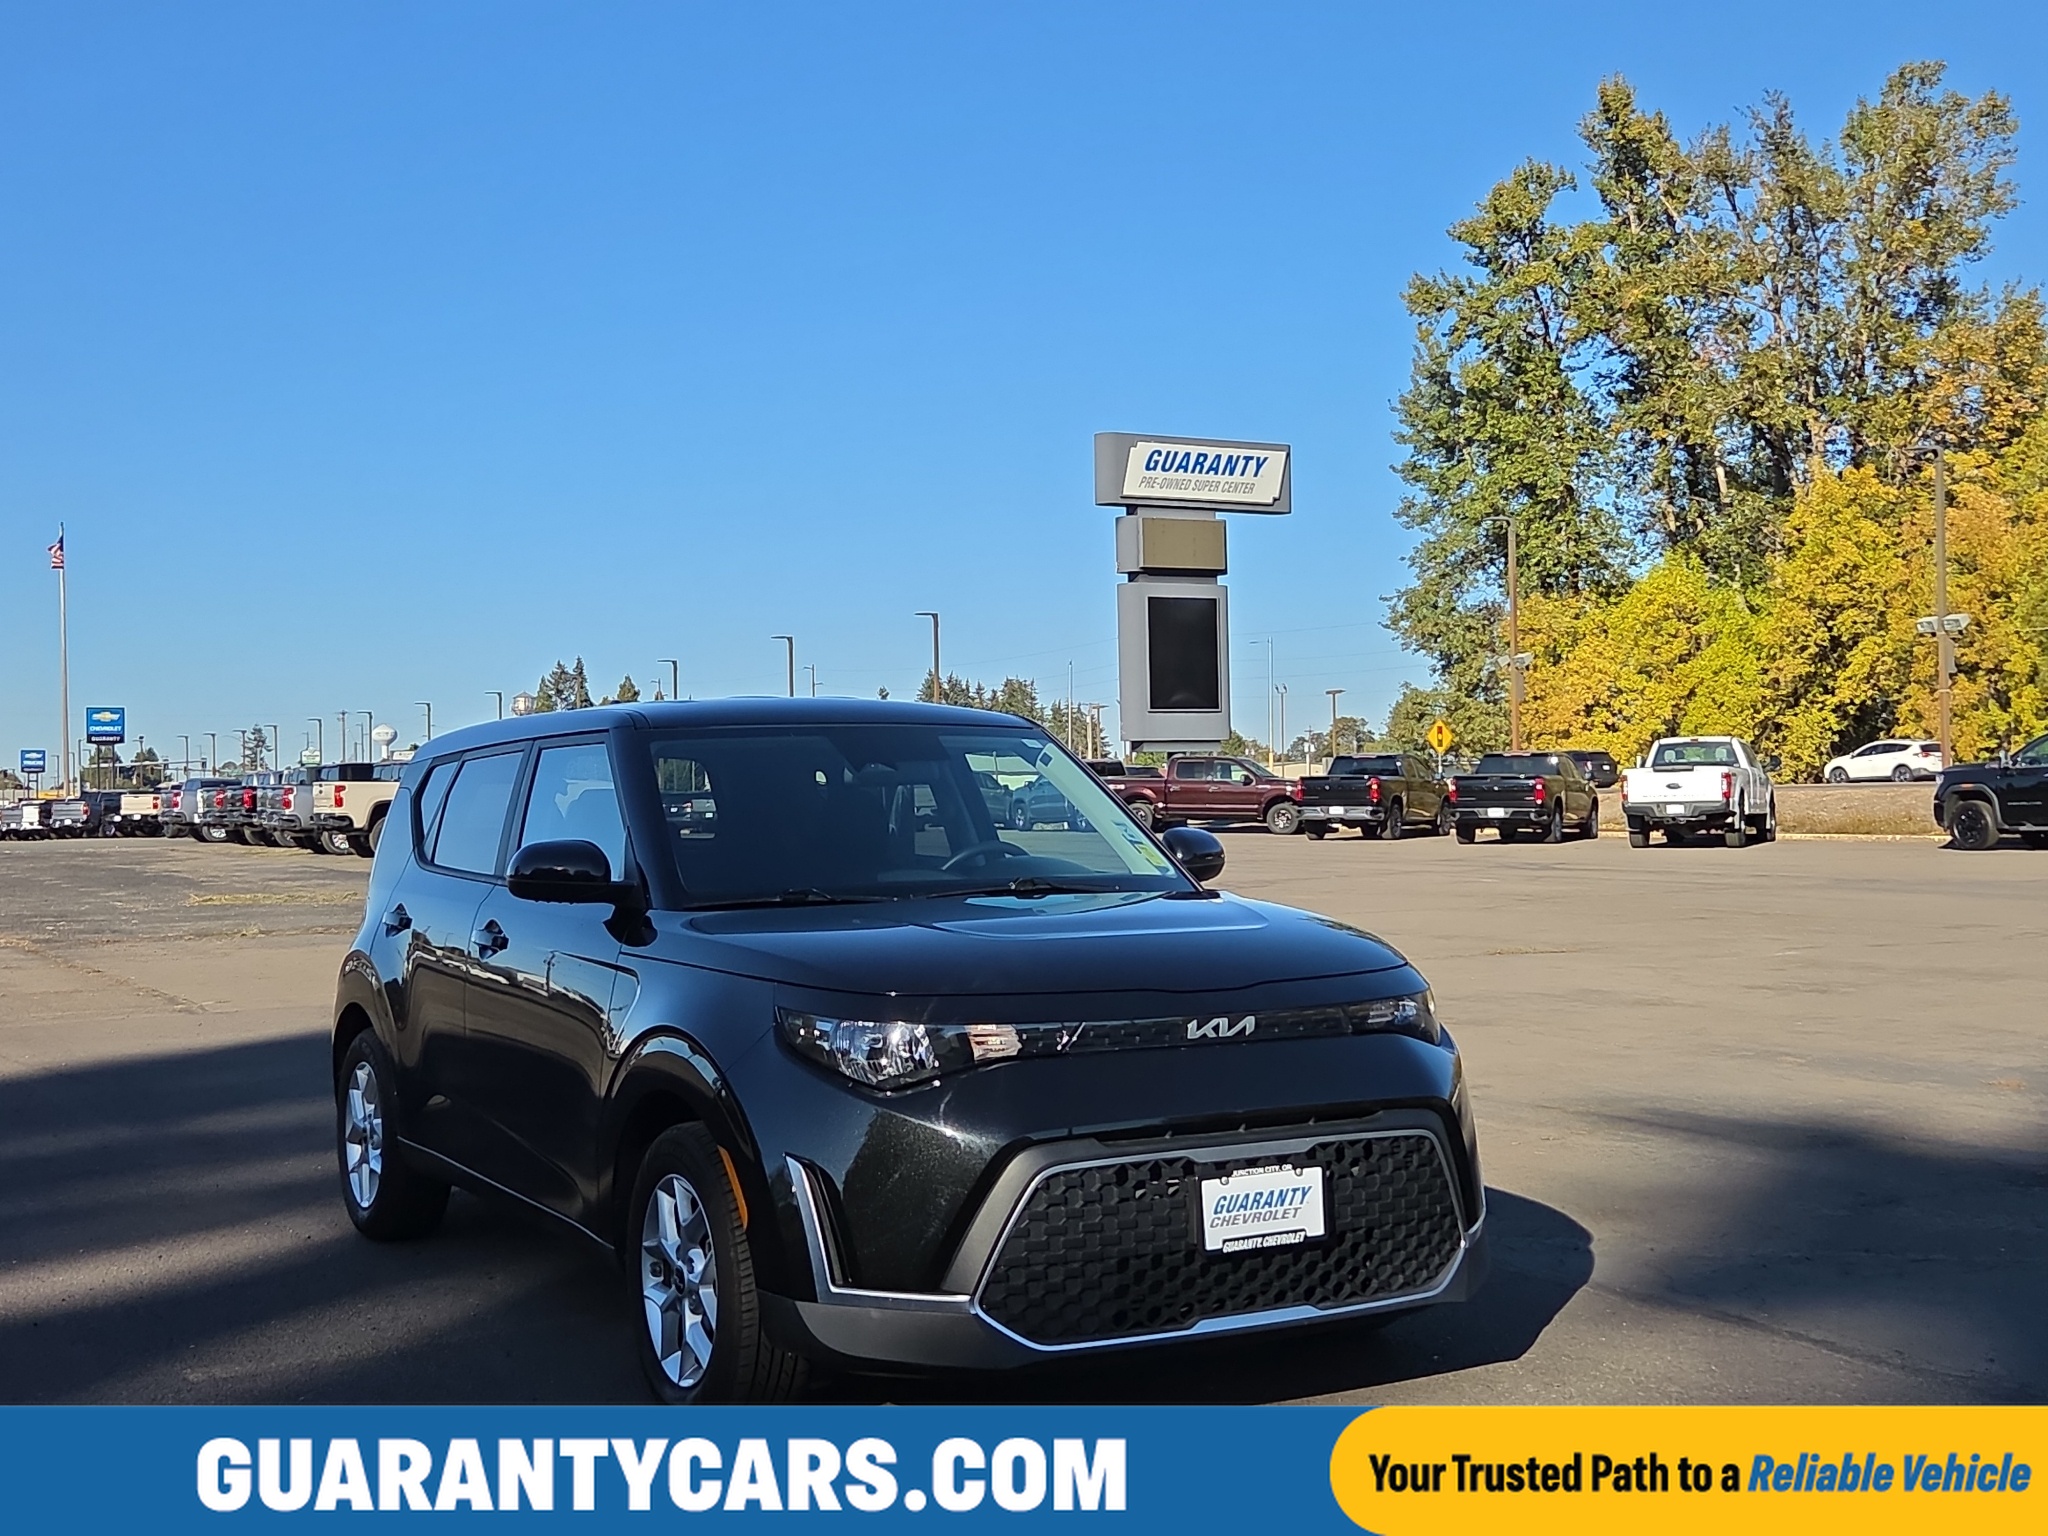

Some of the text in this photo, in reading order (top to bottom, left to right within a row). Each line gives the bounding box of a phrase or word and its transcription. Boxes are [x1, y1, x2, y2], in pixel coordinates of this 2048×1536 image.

[1145, 449, 1269, 478] GUARANTY
[1138, 476, 1256, 495] PRE-OWNED SUPER CENTER
[1187, 1015, 1256, 1040] KIA
[1231, 1167, 1264, 1178] JUNCTION
[1213, 1185, 1312, 1216] GUARANTY
[1209, 1207, 1302, 1229] CHEVROLET
[1262, 1231, 1306, 1248] CHEVROLET
